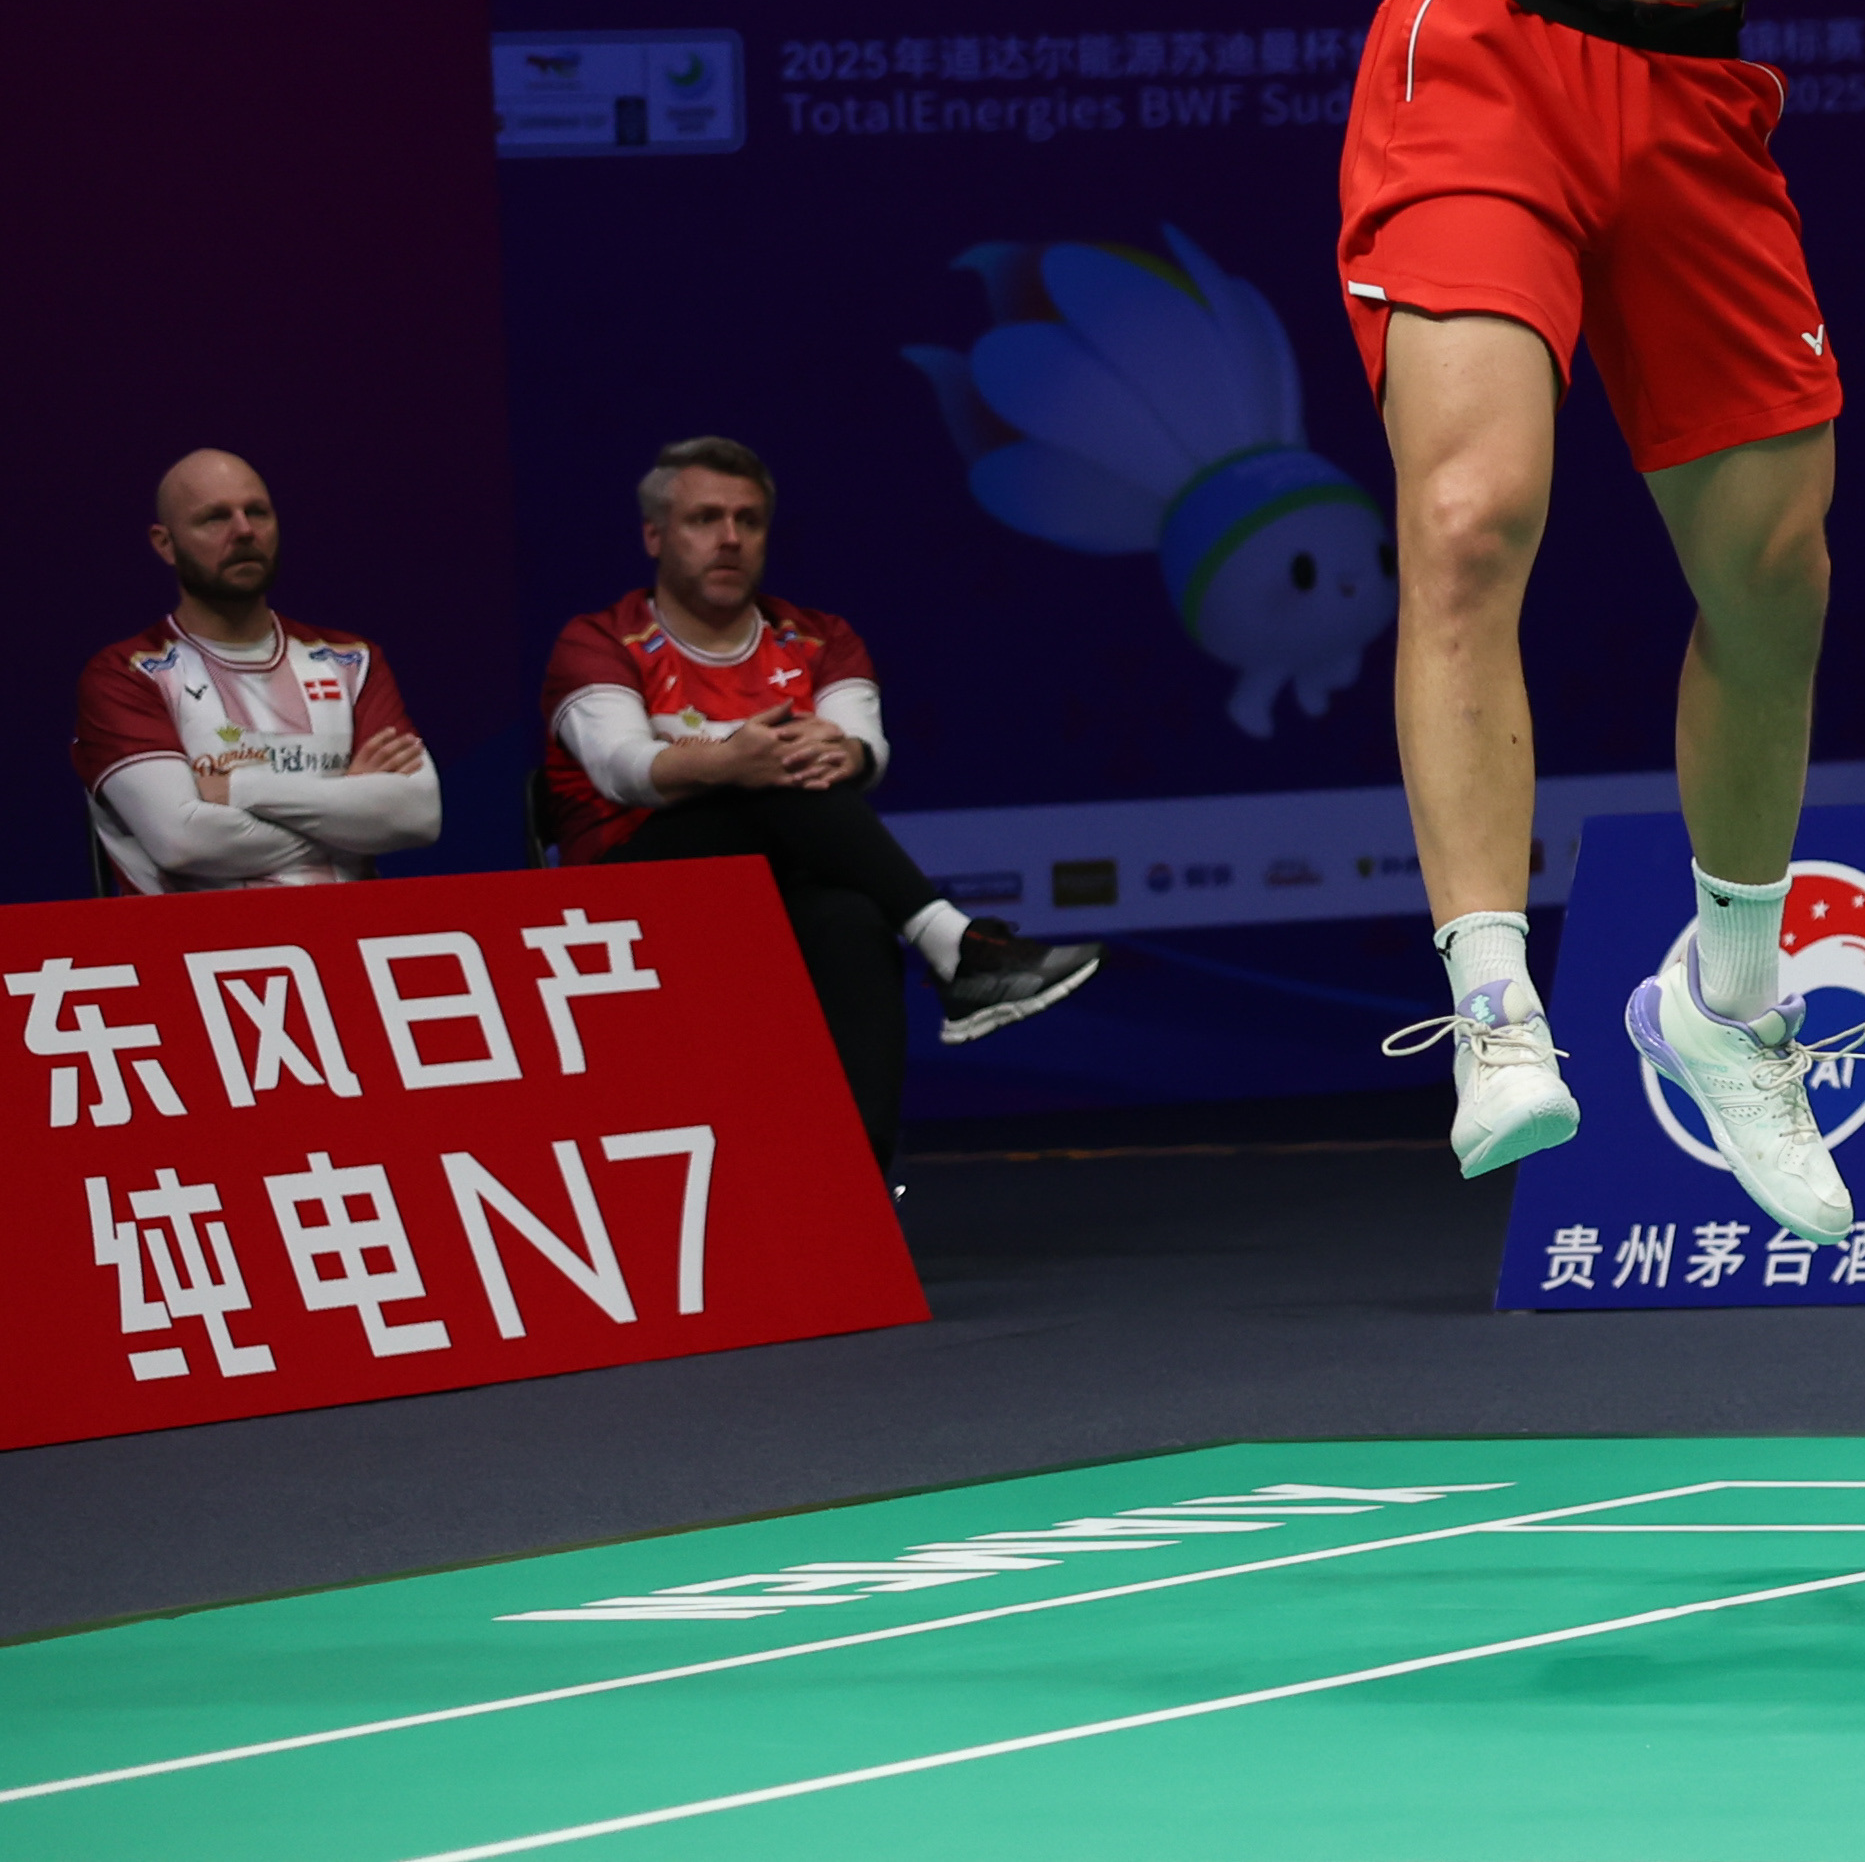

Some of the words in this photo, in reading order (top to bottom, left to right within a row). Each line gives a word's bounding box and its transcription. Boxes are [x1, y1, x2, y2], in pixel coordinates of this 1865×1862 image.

[782, 86, 1125, 143] TotalEnergies
[1137, 83, 1245, 130] BWF
[3, 908, 661, 1128] 东风日产
[84, 1124, 716, 1381] 纯电N7
